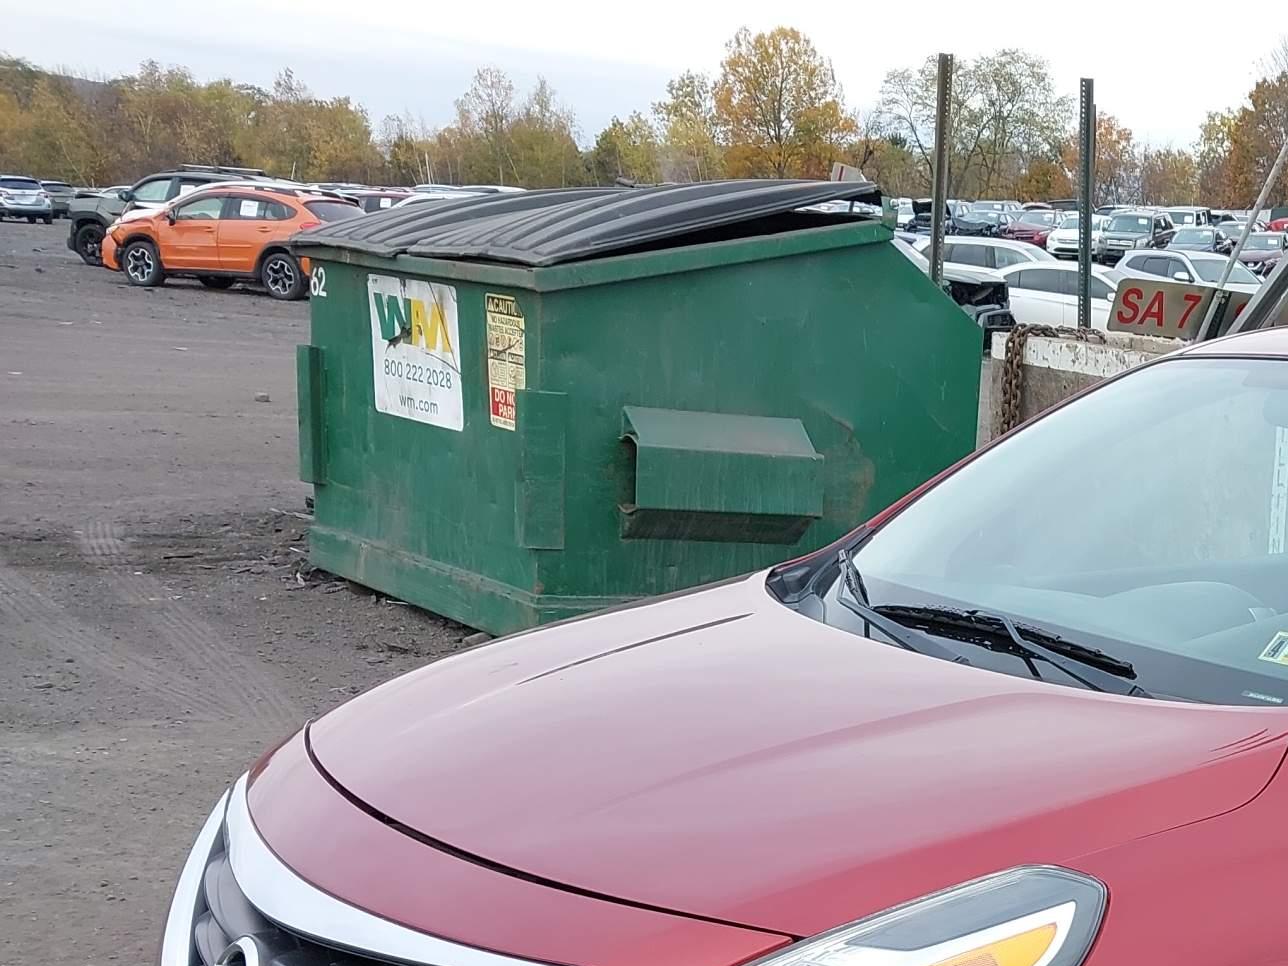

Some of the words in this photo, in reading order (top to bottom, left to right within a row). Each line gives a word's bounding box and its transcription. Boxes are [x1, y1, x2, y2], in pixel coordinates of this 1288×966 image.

[372, 291, 452, 354] WM
[1116, 287, 1165, 327] SA
[1177, 293, 1203, 329] 7
[384, 358, 404, 378] 800
[405, 362, 424, 383] 222
[426, 367, 453, 389] 2028
[399, 394, 439, 414] wm.com
[494, 389, 506, 404] DO
